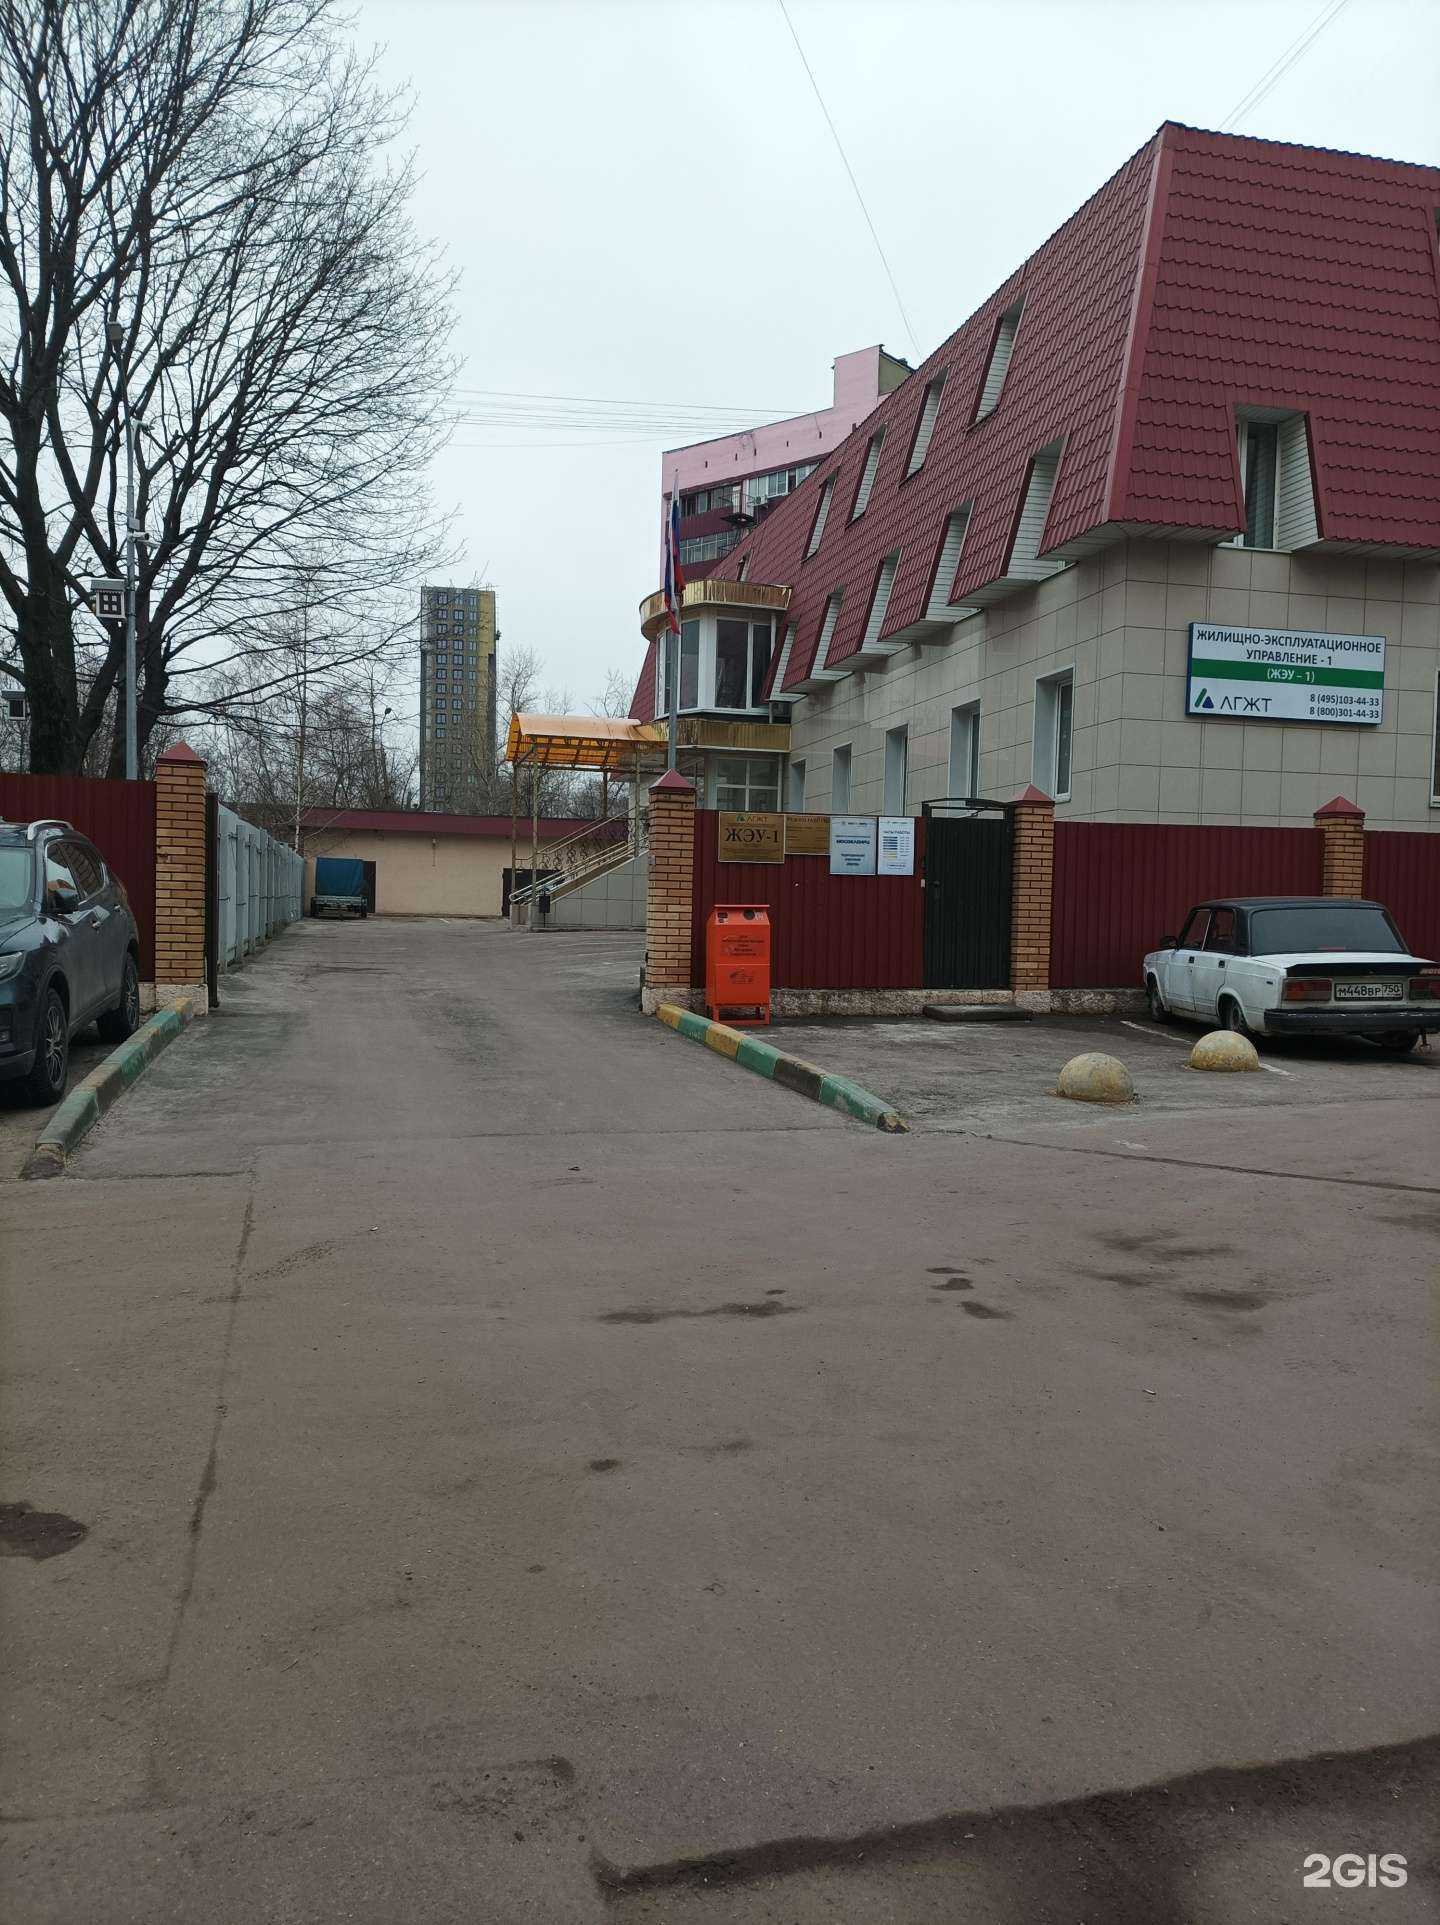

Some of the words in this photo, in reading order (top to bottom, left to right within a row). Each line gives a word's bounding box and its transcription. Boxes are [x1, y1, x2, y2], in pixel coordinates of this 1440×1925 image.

[1197, 629, 1381, 653] ЖИЛИЩНО-ЭКСПЛУАТАЦИОННОЕ
[1246, 649, 1318, 665] УПРАВЛЕНИЕ
[1327, 655, 1332, 665] 1
[1317, 694, 1380, 707] (495)103-44-33
[1317, 707, 1380, 719] (800)301-44-33
[725, 827, 779, 843] ЖЭУ-1
